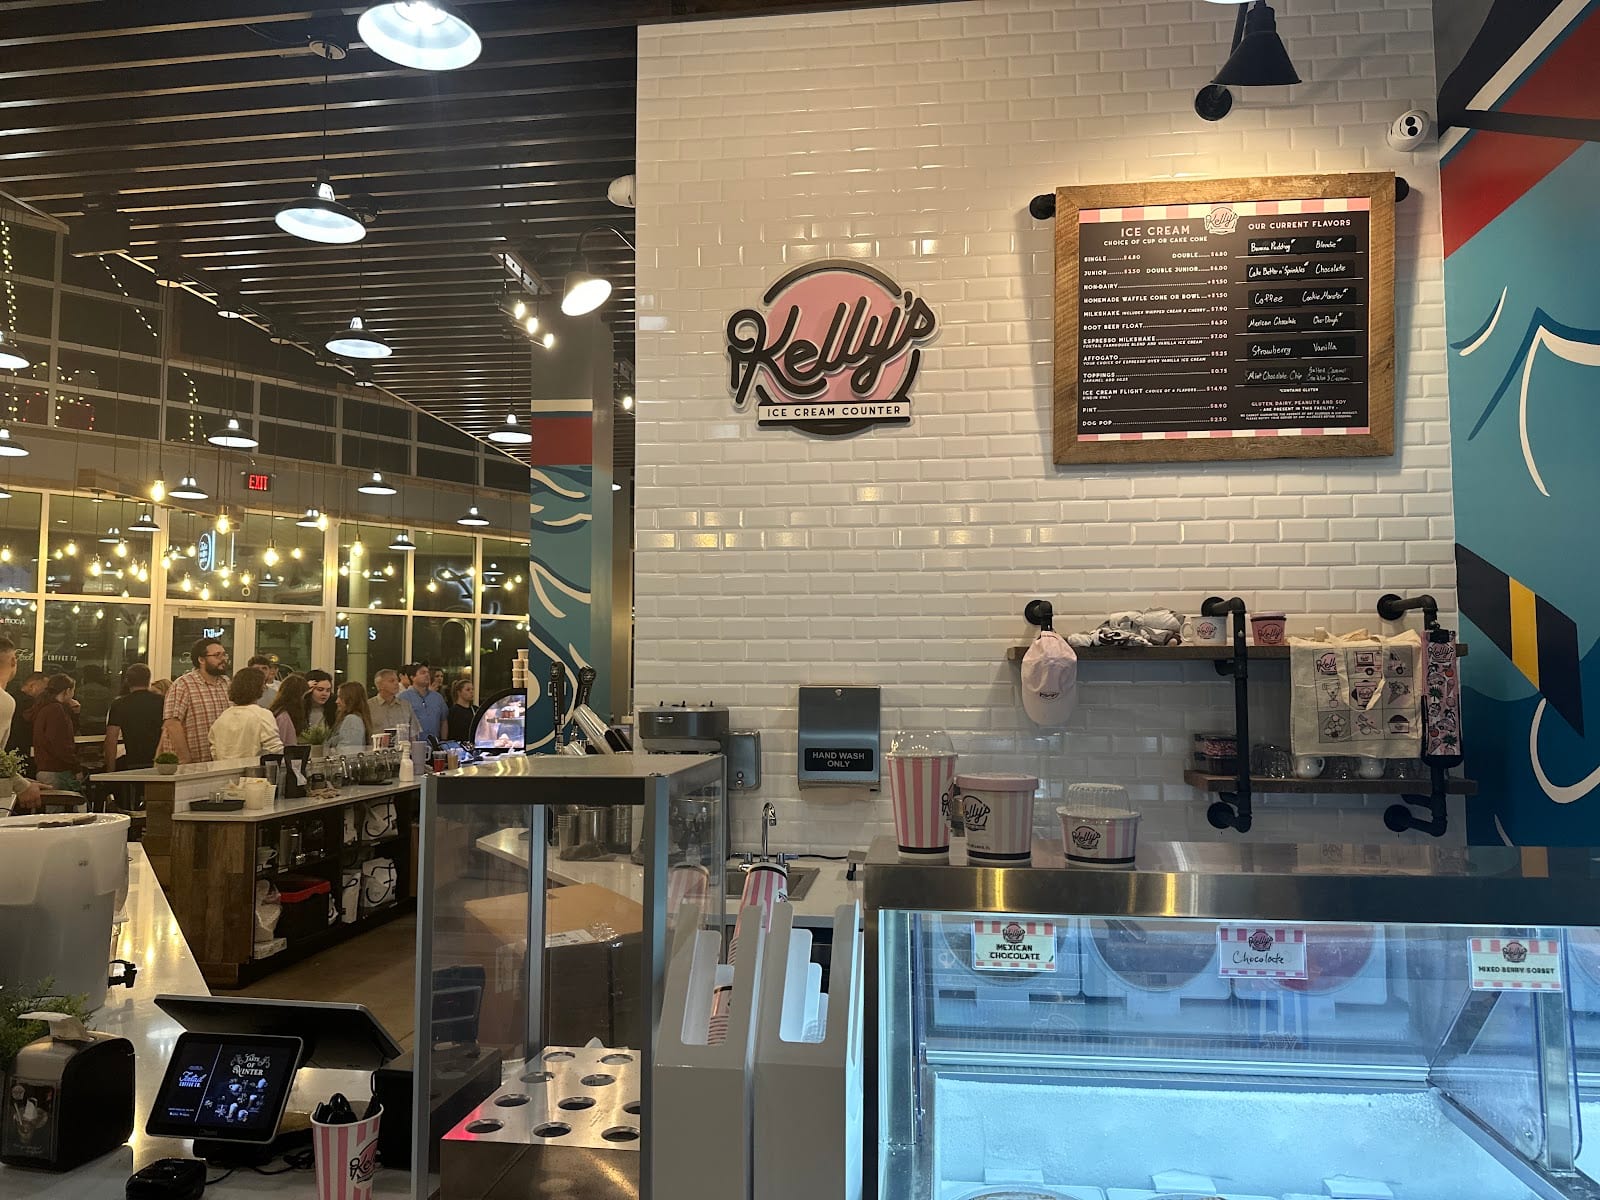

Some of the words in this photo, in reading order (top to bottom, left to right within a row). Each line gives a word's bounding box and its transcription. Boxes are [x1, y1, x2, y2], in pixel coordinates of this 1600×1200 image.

[1269, 221, 1309, 229] CURRENT
[1312, 219, 1351, 228] FLAVORS
[1120, 227, 1141, 237] ICE
[1147, 225, 1190, 235] CREAM
[1270, 241, 1291, 253] Pudding
[1248, 267, 1261, 278] Cake
[1315, 263, 1346, 274] Chocolate
[1083, 296, 1120, 304] HOMEMADE
[1254, 293, 1284, 305] Coffee
[1302, 291, 1320, 302] Cookie
[1320, 290, 1344, 301] Monster
[1248, 319, 1271, 328] Mexican
[727, 291, 936, 403] Kelly's
[1252, 345, 1291, 356] Strawberry
[1312, 342, 1337, 352] Vanilla
[767, 409, 787, 417] ICE
[794, 407, 835, 417] CREAM
[842, 406, 901, 416] COUNTER
[249, 474, 268, 490] EXIT
[812, 751, 837, 759] HAND
[839, 752, 865, 760] WASH
[827, 760, 850, 768] ONLY
[996, 944, 1033, 952] MEXICAN
[989, 952, 1040, 960] CHOCOLATE
[1232, 950, 1284, 965] Chocolate
